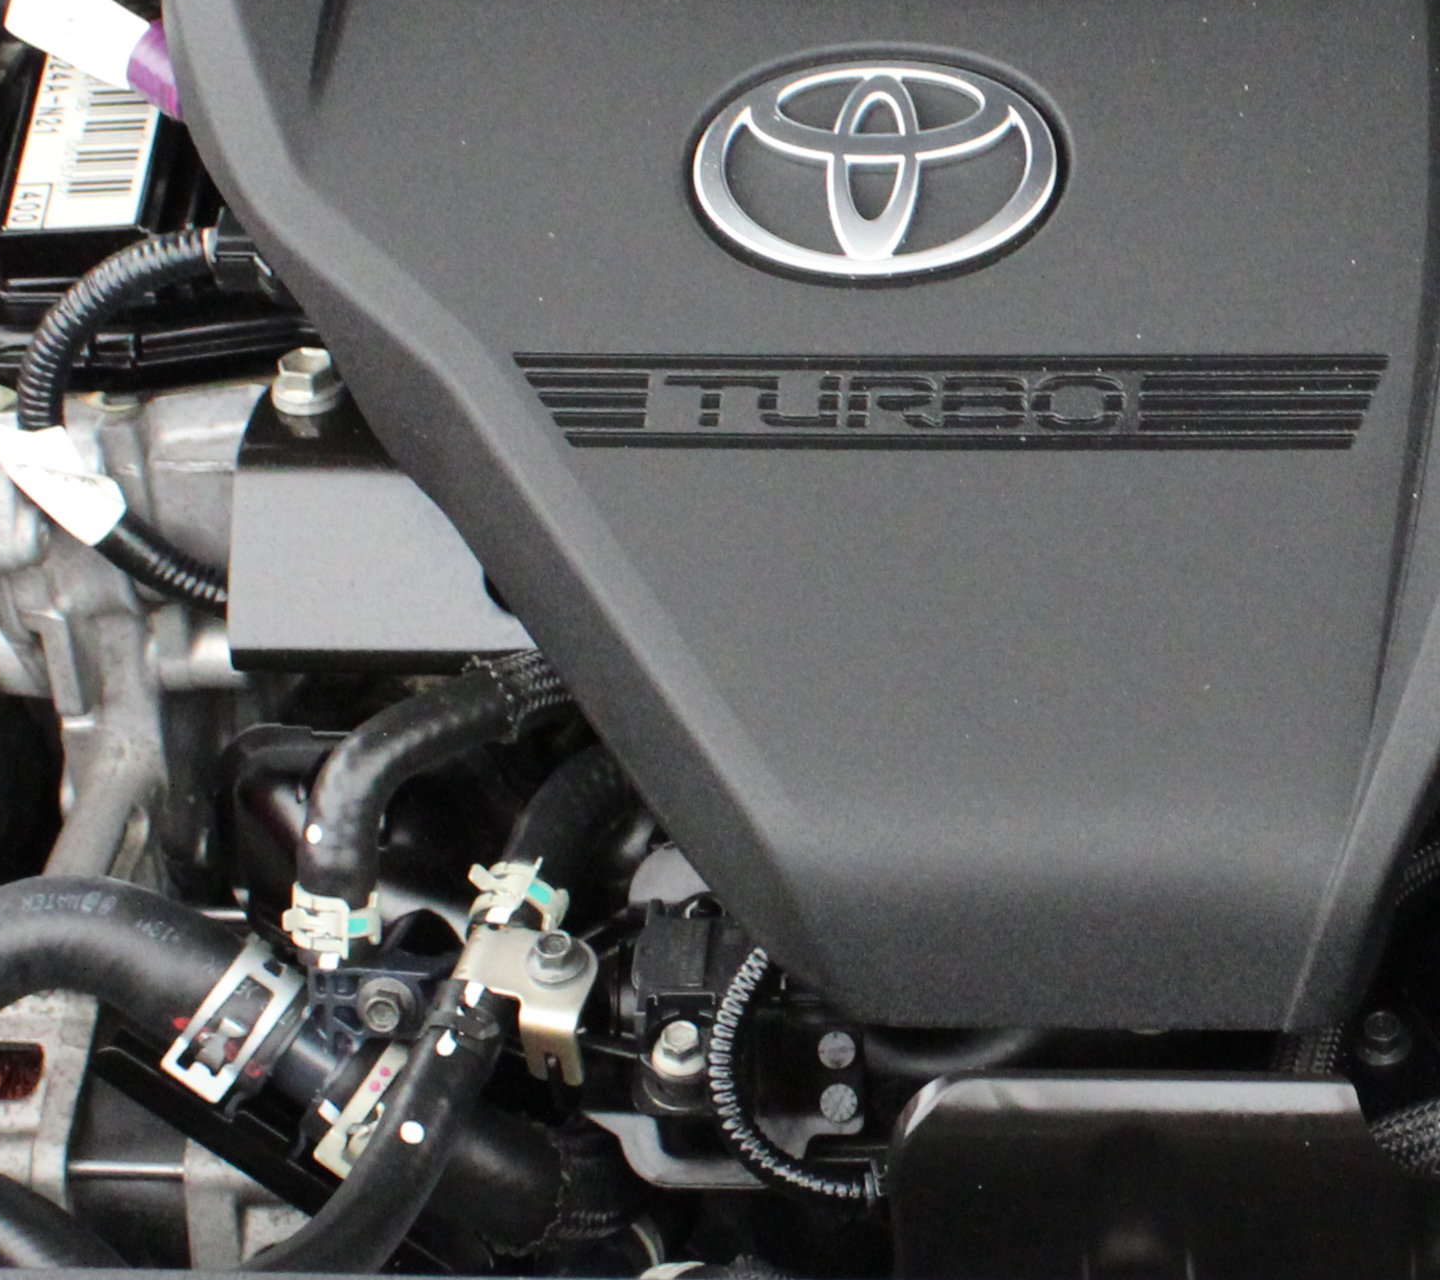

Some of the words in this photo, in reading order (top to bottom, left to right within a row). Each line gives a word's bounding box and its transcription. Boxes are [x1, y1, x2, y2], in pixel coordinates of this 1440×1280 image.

[32, 54, 75, 135] 24A-N21
[9, 190, 43, 225] 400
[663, 373, 1125, 429] TURBO
